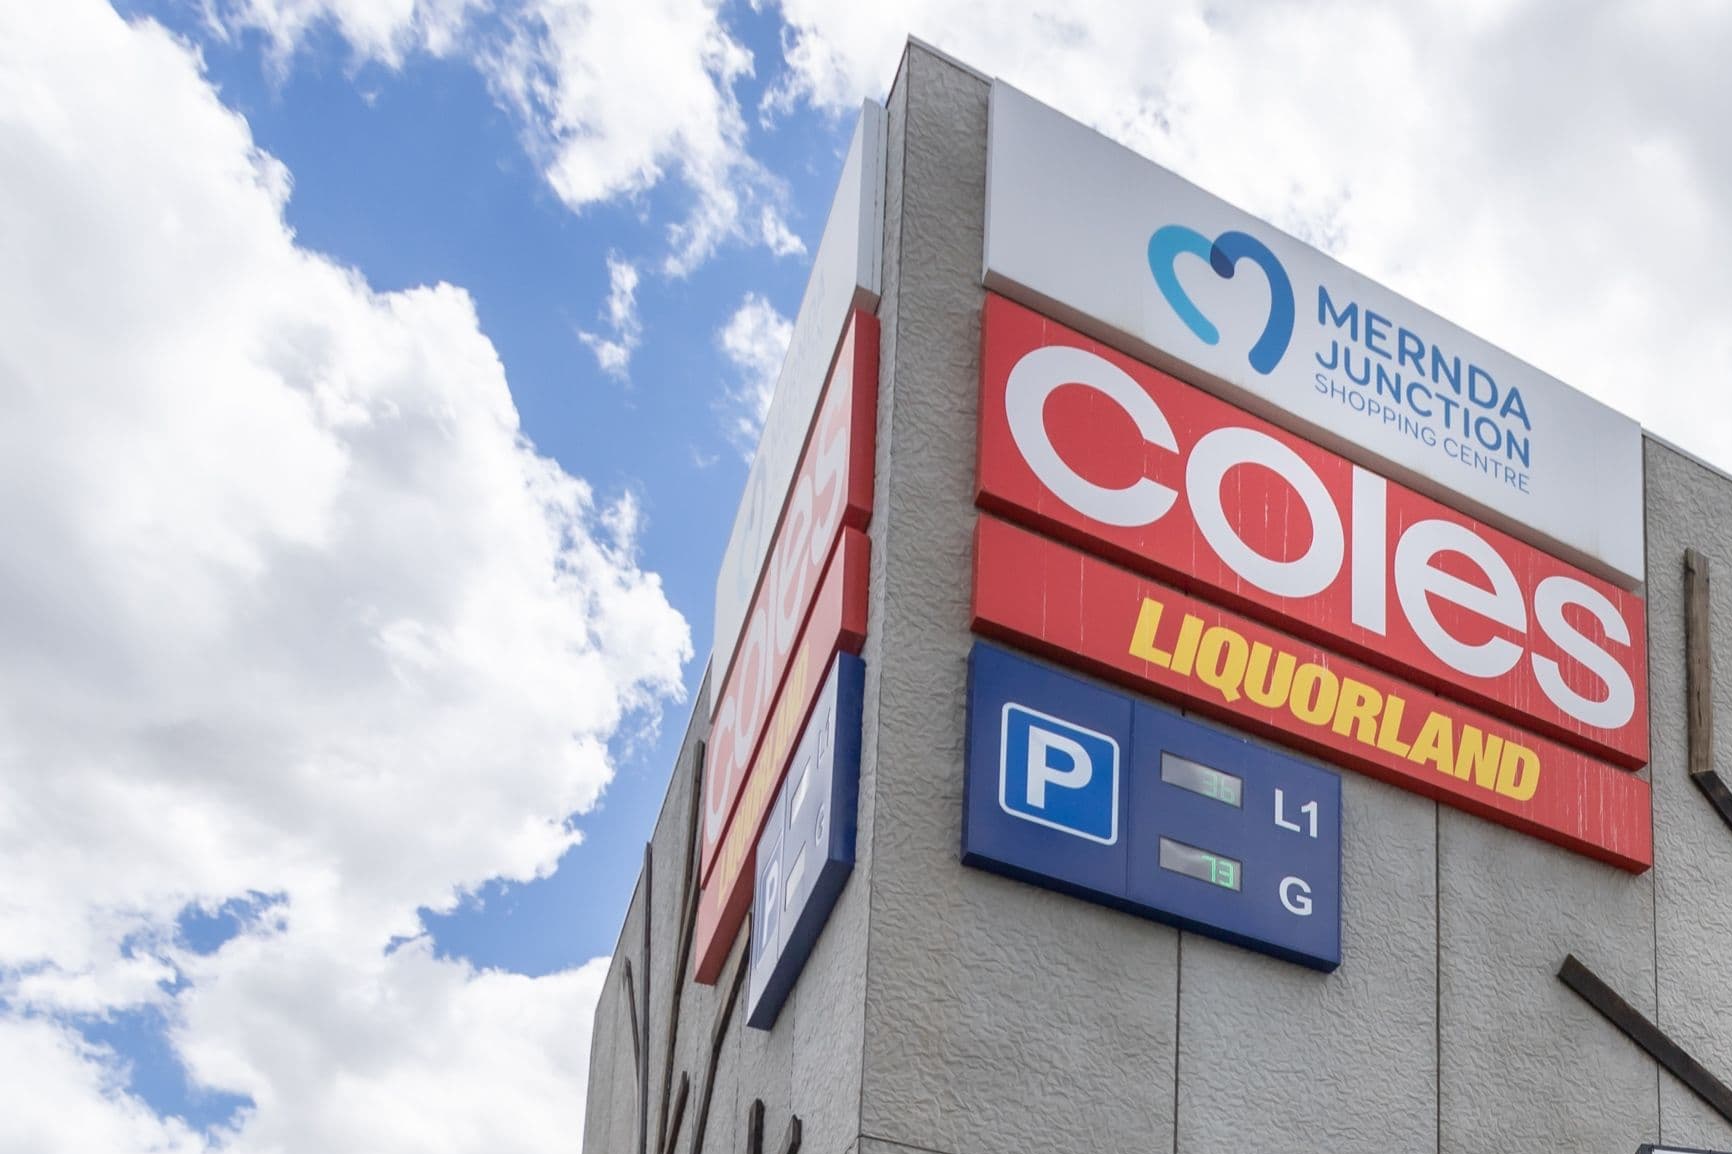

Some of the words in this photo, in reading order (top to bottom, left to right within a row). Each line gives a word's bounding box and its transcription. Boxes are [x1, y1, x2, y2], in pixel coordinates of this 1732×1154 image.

[1315, 340, 1530, 469] JUNCTION
[1318, 284, 1532, 431] MERNDA
[1315, 373, 1437, 447] SHOPPING
[1443, 437, 1531, 495] CENTRE
[1005, 346, 1635, 729] coles
[1129, 597, 1540, 802] LIQUORLAND
[1026, 725, 1093, 809] P
[1274, 788, 1318, 838] L1
[1278, 876, 1313, 915] G
